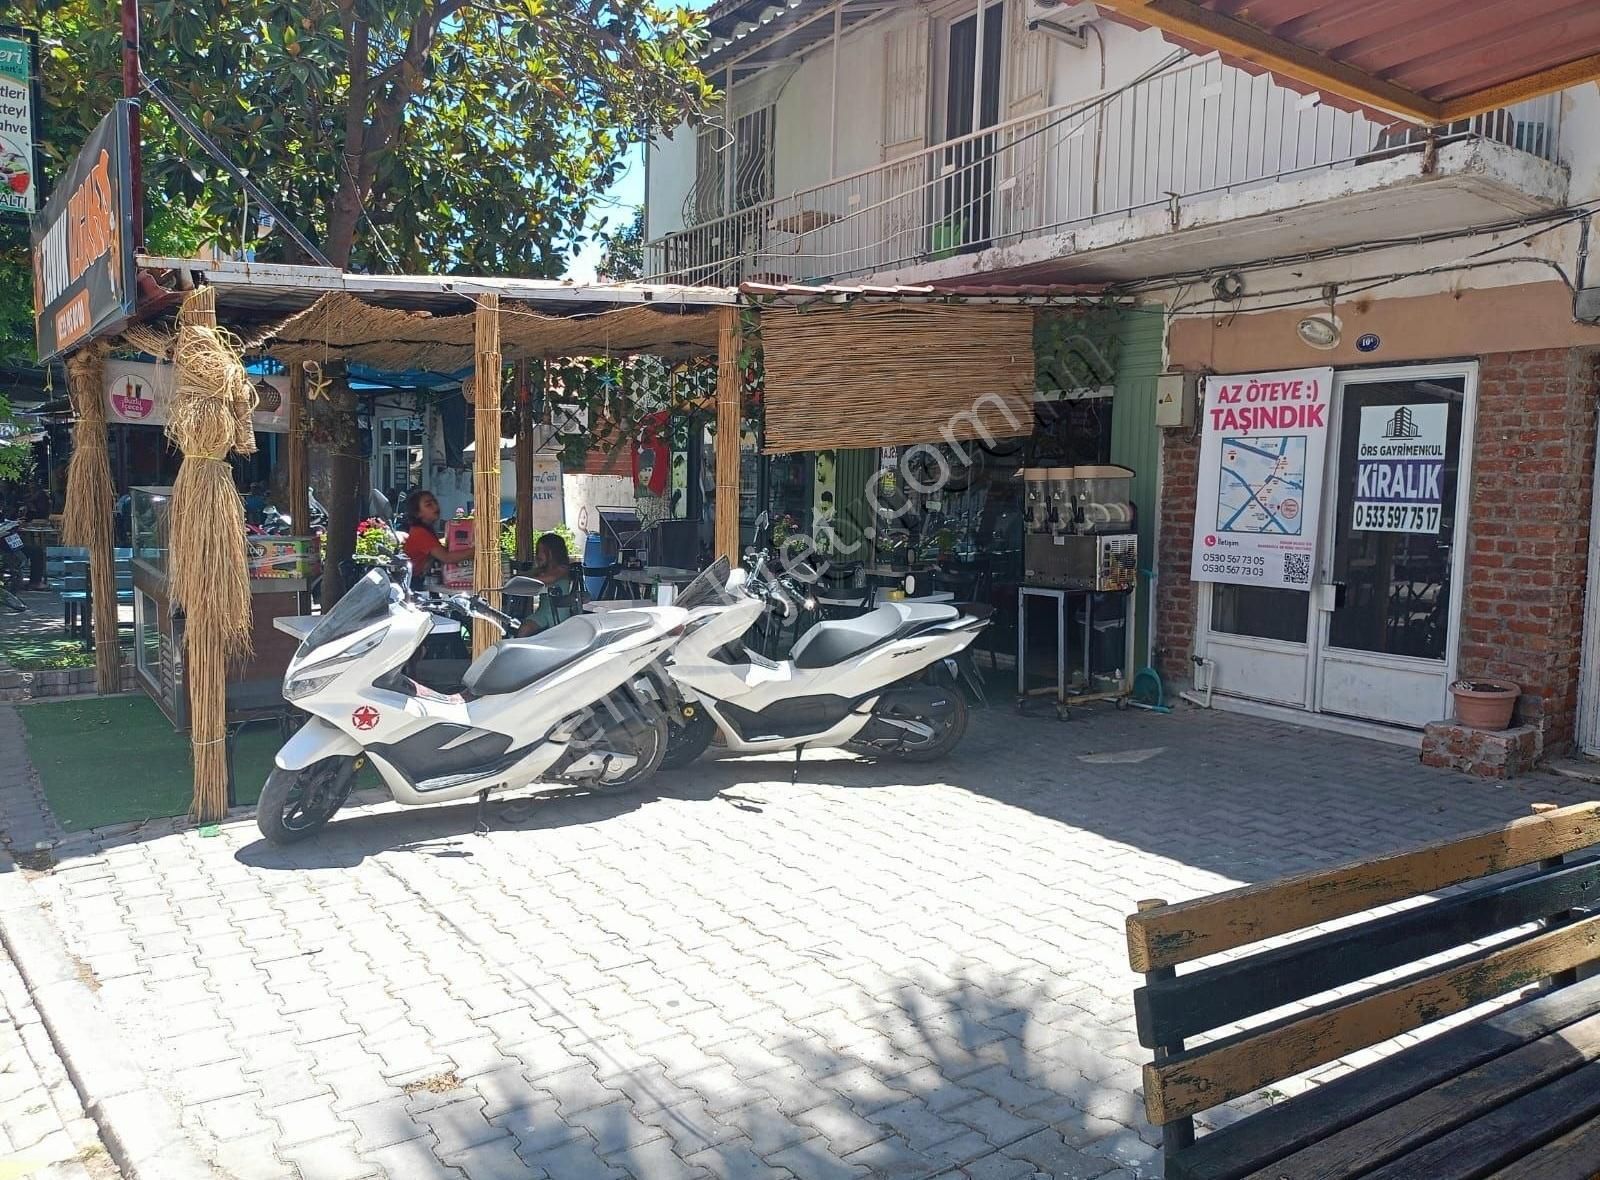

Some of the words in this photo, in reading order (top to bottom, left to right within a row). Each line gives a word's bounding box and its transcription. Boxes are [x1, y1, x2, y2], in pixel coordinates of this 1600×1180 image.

[0, 104, 26, 119] teyl
[1218, 384, 1243, 404] AZ
[1246, 379, 1304, 403] ÖTEYE
[1306, 379, 1319, 403] :)
[1210, 404, 1326, 435] TAŞINDIK
[1361, 443, 1378, 456] ÖRS
[1380, 443, 1443, 456] GAYRİMENKUL
[1356, 505, 1363, 527] 0
[1365, 505, 1385, 528] 533
[1387, 506, 1408, 529] 597
[1410, 506, 1424, 530] 75
[1426, 507, 1439, 530] 17
[1203, 553, 1226, 563] 0530
[1227, 554, 1241, 564] 567
[1242, 555, 1252, 565] 73
[1253, 556, 1265, 566] 05
[1202, 563, 1225, 573] 0530
[1226, 565, 1240, 575] 567
[1241, 566, 1251, 576] 73
[1252, 567, 1264, 577] 03
